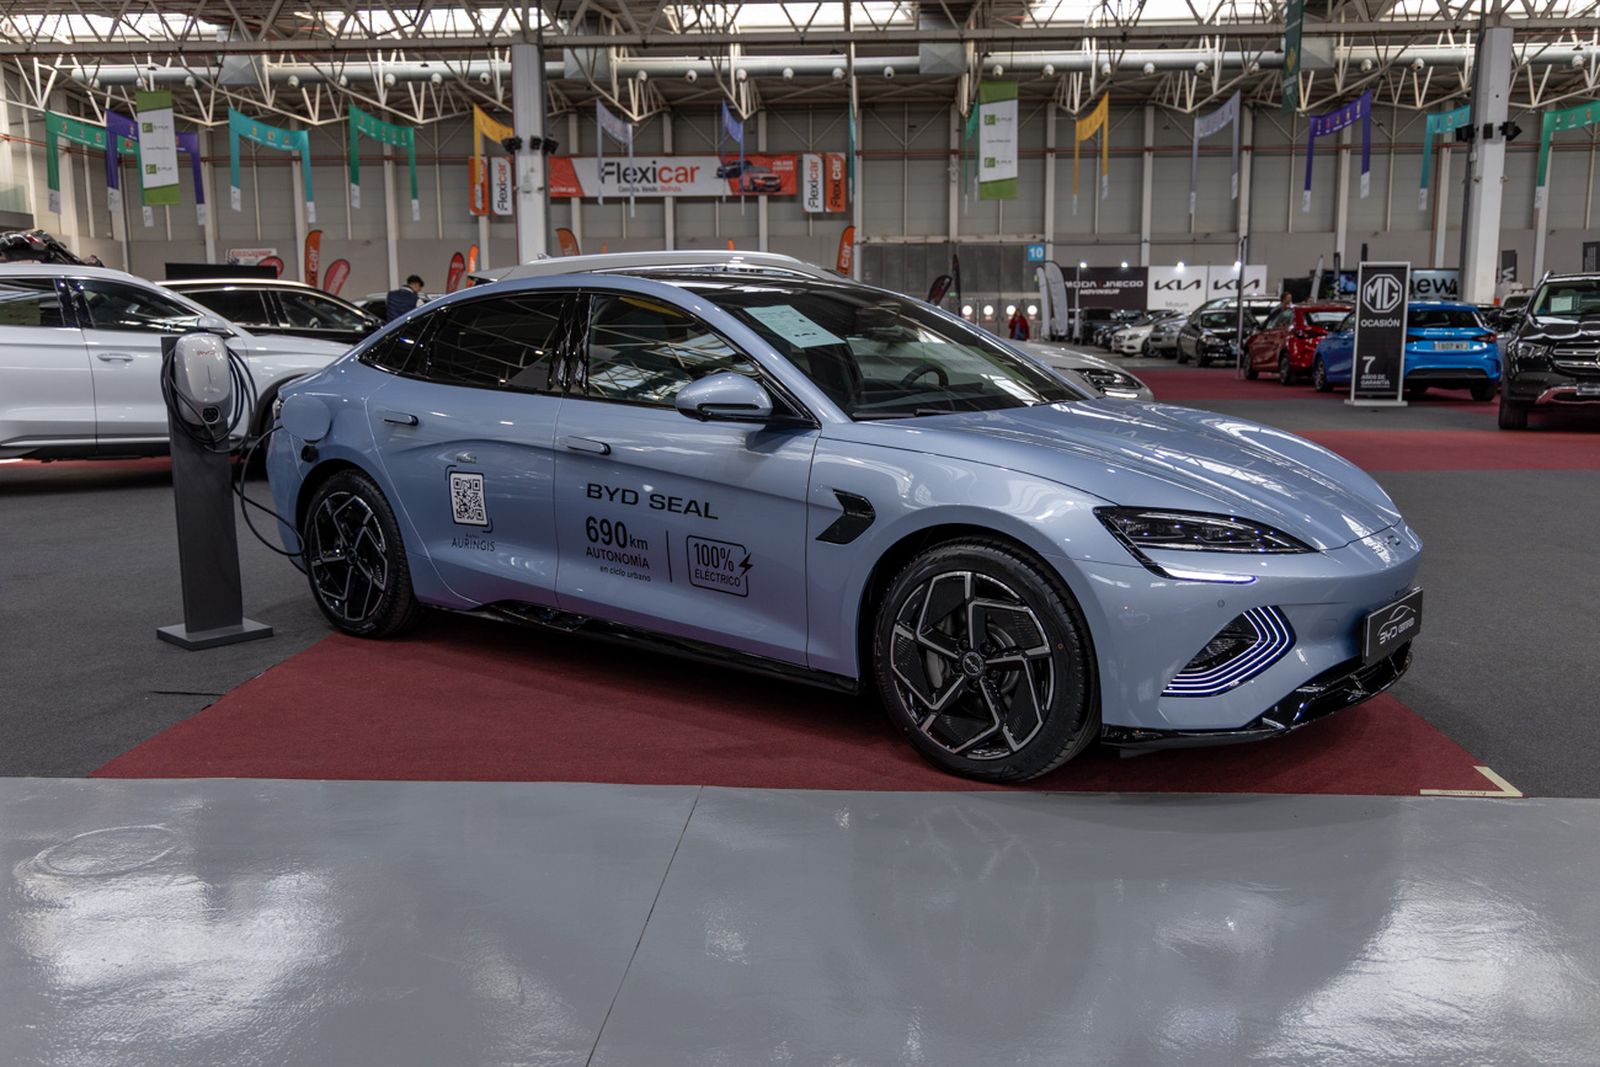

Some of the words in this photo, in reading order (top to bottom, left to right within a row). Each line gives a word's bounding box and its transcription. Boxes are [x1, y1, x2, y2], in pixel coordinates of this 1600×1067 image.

[601, 160, 699, 184] Flexicar
[497, 163, 508, 211] Flexicar
[808, 160, 819, 208] Flexicar
[830, 159, 842, 208] Flexicar
[1029, 247, 1044, 258] 10
[1103, 280, 1145, 288] JAECOO
[1154, 279, 1201, 290] KIA
[1367, 278, 1399, 309] MG
[1361, 318, 1400, 327] OCASIÓN
[1362, 356, 1376, 374] 7
[587, 483, 639, 505] BYD
[649, 493, 719, 520] SEAL
[451, 537, 496, 552] AURINGIS
[586, 547, 650, 569] AUTONOMÍA
[693, 542, 734, 572] 100%
[600, 565, 609, 573] en
[610, 566, 626, 577] ciclo
[627, 570, 652, 582] urbano
[694, 568, 741, 588] ELÉCTRICO
[1379, 625, 1398, 645] BYD
